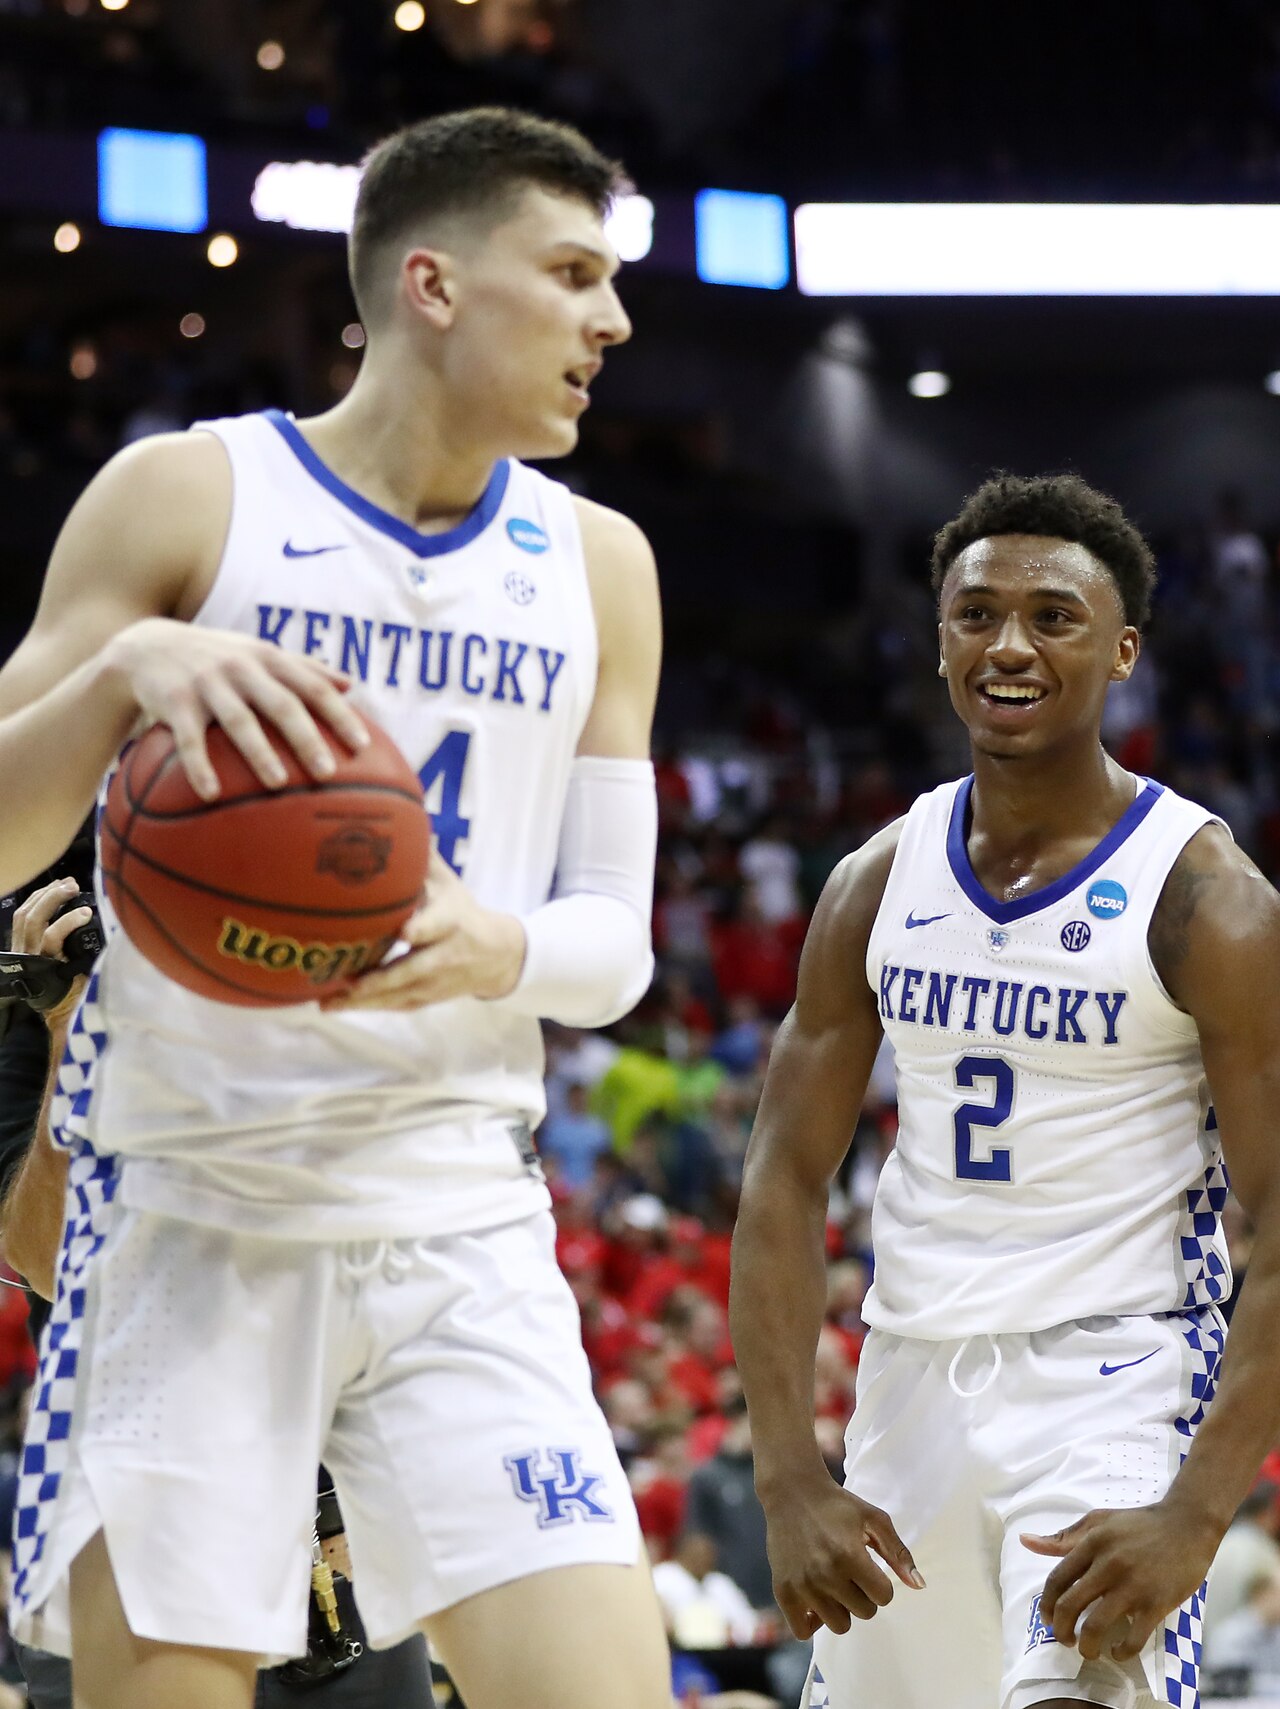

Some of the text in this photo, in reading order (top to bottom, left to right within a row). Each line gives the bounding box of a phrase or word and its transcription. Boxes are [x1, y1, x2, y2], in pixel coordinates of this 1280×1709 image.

[1062, 921, 1090, 951] SEC
[1090, 895, 1124, 911] NCAA
[880, 965, 1127, 1044] KENTUCKY
[953, 1056, 1014, 1181] 2
[503, 1446, 615, 1529] UK
